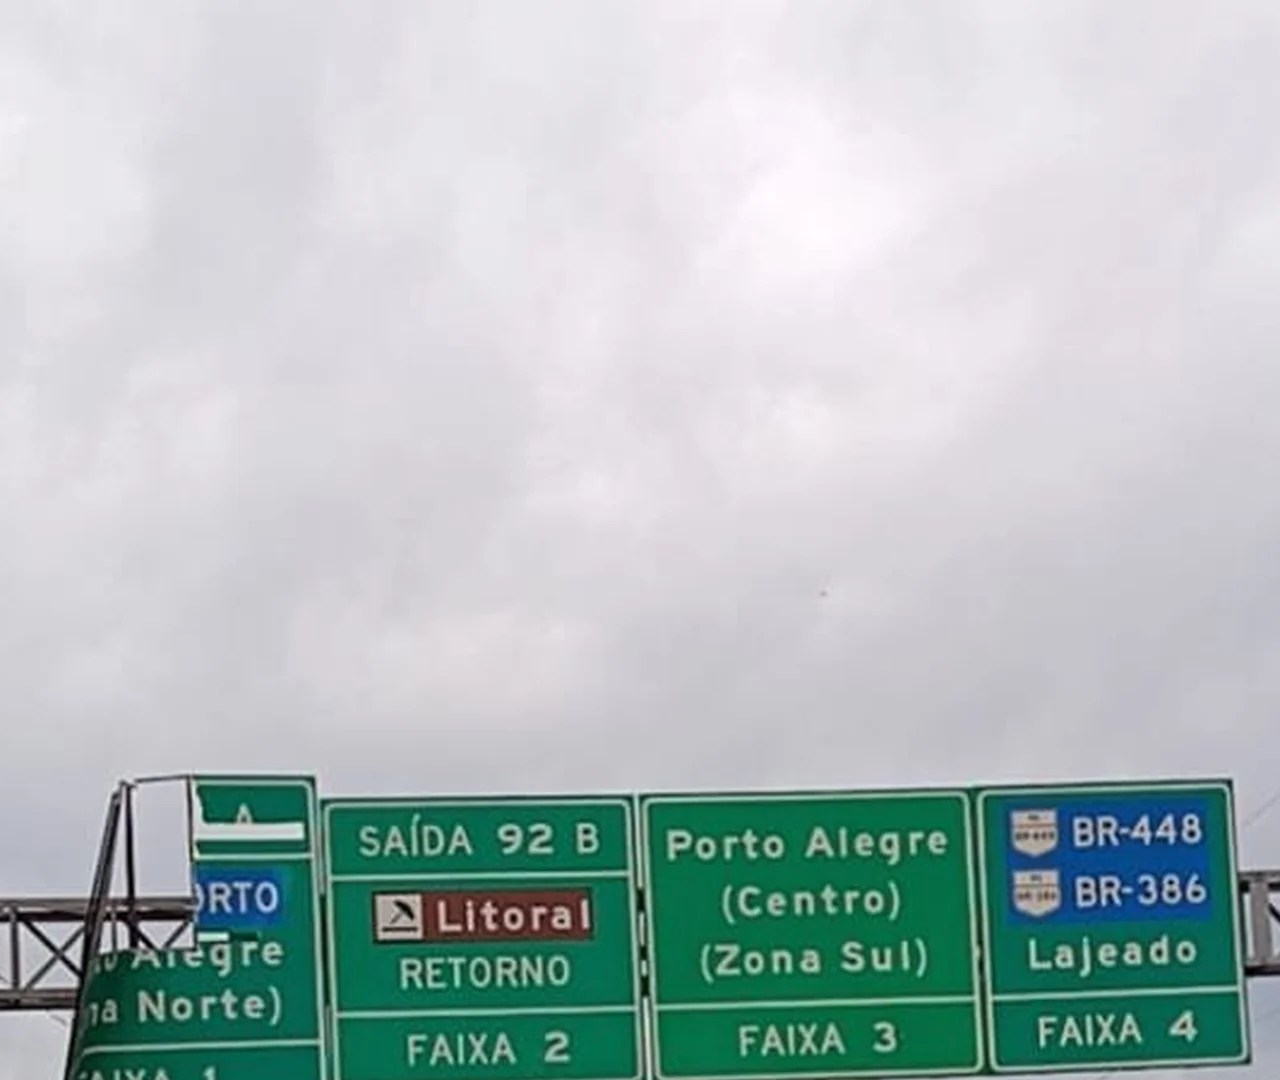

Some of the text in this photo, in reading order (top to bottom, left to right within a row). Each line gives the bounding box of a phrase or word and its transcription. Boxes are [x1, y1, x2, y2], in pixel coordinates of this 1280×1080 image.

[359, 813, 599, 857] SAÍDA 92 B
[666, 826, 949, 866] Porto Alegre
[1073, 813, 1202, 847] BR-448
[722, 880, 900, 925] (Centro)
[1075, 873, 1207, 909] BR-386
[437, 900, 590, 932] Litoral
[400, 955, 570, 990] RETORNO
[700, 937, 928, 984] (Zona Sul)
[1028, 935, 1197, 978] Lajeado
[137, 985, 282, 1026] Norte)
[738, 1021, 898, 1057] FAIXA 3
[1038, 1009, 1198, 1048] FAIXA 4
[407, 1031, 570, 1067] FAIXA 2
